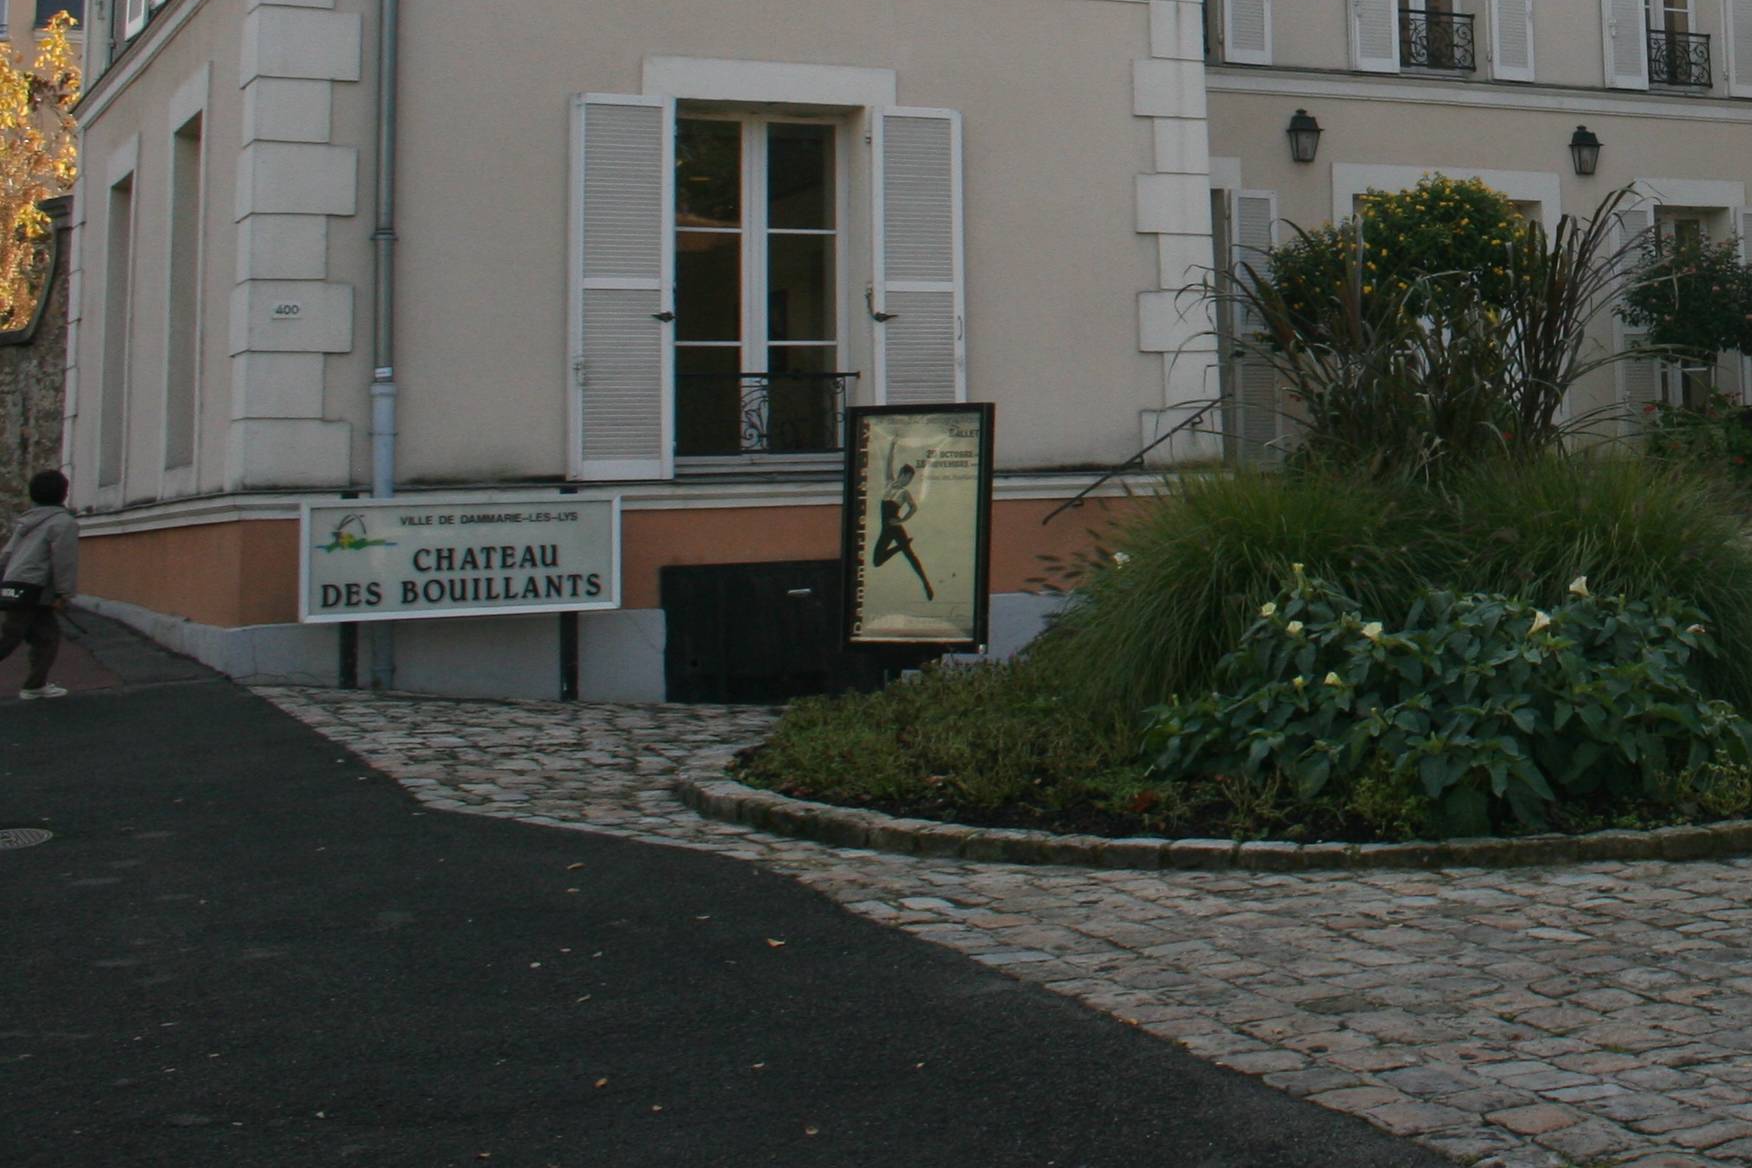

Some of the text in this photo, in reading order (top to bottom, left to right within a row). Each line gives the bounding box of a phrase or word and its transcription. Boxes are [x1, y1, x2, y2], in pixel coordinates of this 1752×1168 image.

[275, 304, 300, 315] 400
[400, 511, 578, 526] VILLE DE DAMMARIE-LES-LYS
[413, 544, 560, 572] CHATEAU
[320, 573, 602, 608] DES BOUILLANTS
